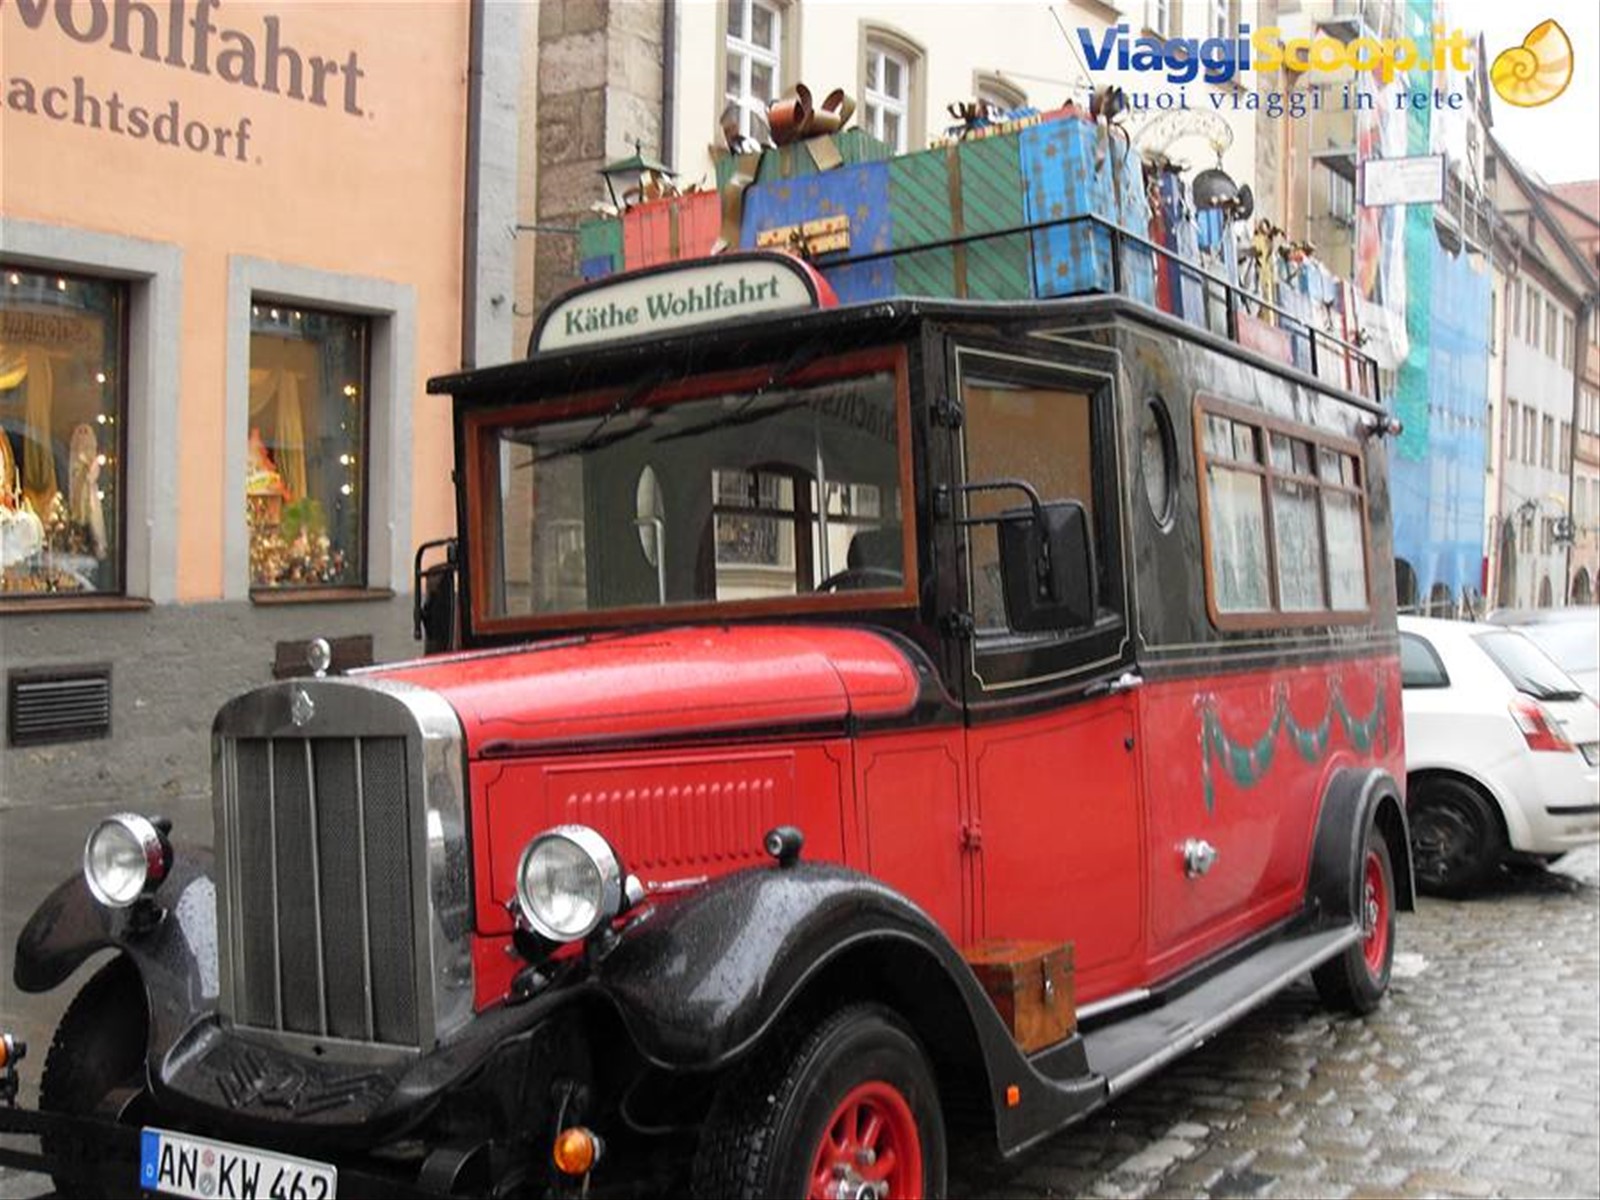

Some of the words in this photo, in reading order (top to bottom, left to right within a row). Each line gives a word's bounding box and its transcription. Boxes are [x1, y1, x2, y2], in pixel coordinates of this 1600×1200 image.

[5, 75, 253, 162] achtsdorf
[564, 303, 639, 336] Käthe
[646, 275, 780, 322] Wohlfahrt
[158, 1142, 199, 1191] AN
[218, 1153, 262, 1200] KW
